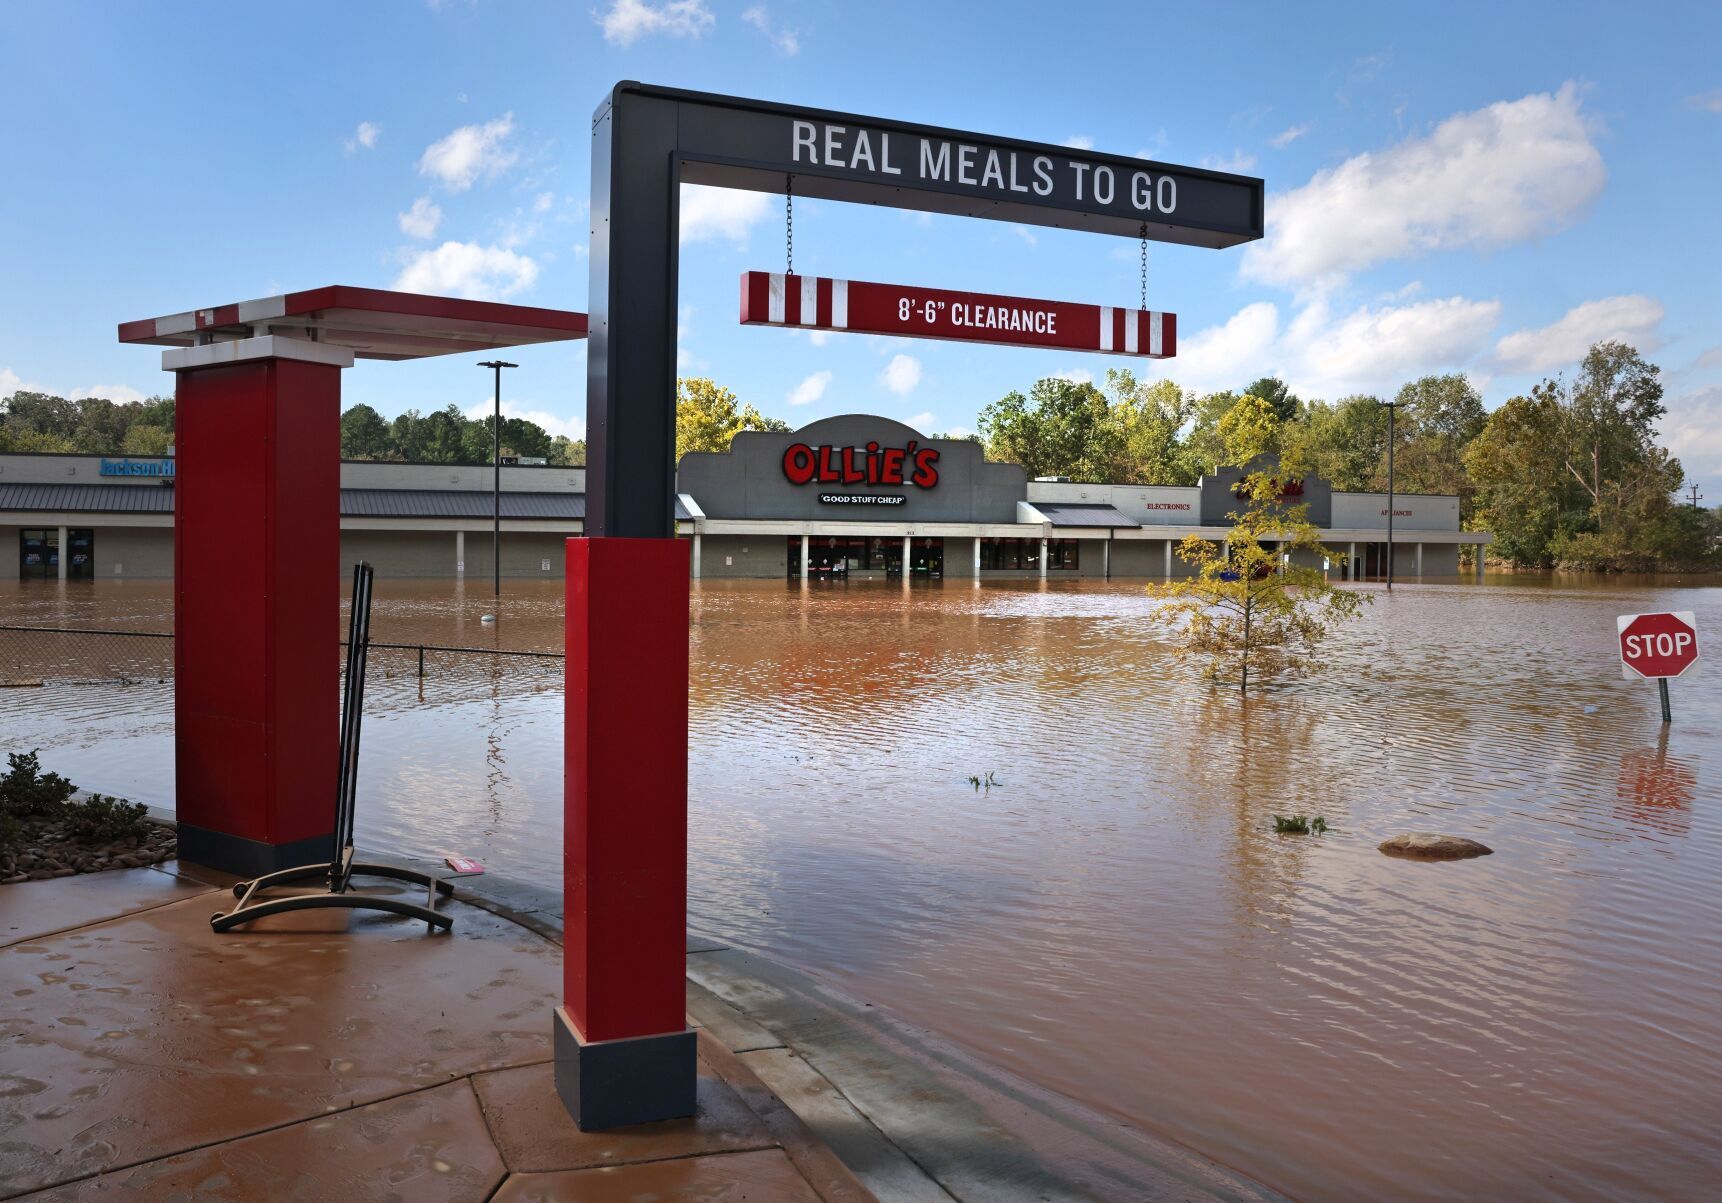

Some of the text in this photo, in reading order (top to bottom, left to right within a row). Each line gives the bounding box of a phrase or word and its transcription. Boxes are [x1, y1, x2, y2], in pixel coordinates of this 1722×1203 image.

[792, 120, 1177, 214] REAL MEALS TO GO
[951, 302, 1057, 335] CLEARANCE
[851, 496, 877, 504] STUFF
[1146, 502, 1191, 511] ELECTRONICS
[1380, 509, 1413, 517] APIANCES
[1626, 632, 1692, 659] STOP
